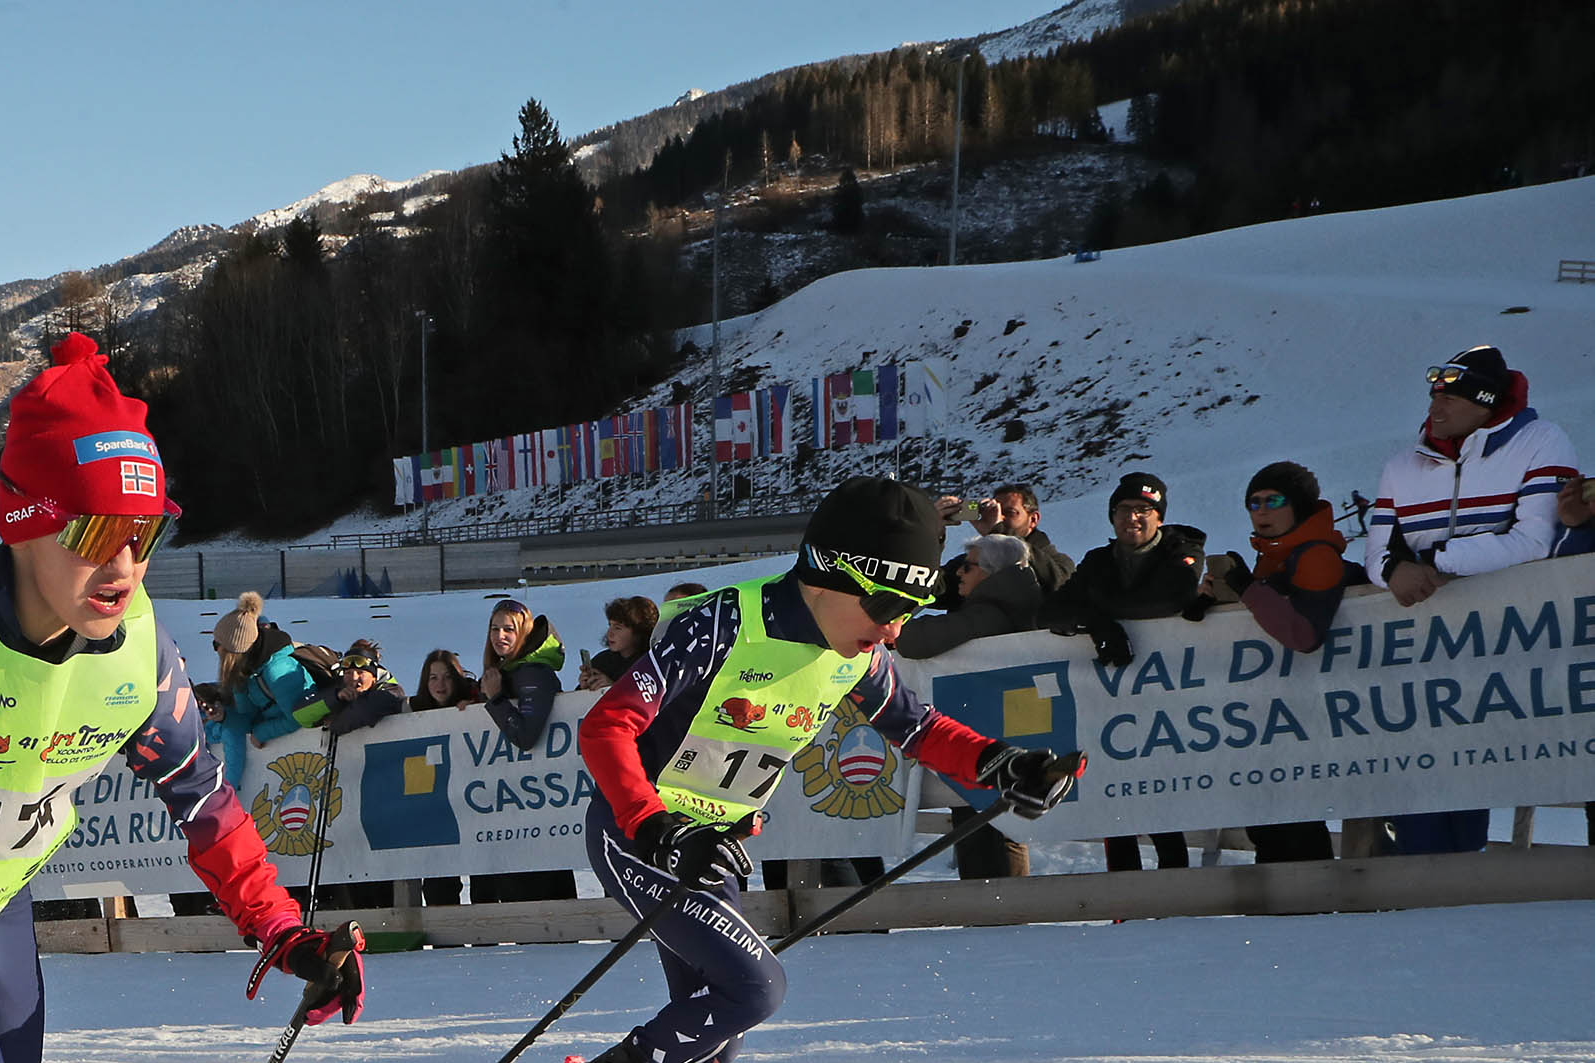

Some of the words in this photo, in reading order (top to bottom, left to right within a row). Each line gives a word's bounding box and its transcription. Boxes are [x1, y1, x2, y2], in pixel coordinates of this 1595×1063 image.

[1476, 390, 1495, 404] HH
[95, 438, 148, 453] SpareBank
[5, 505, 36, 524] CRAF
[1320, 595, 1595, 674] FIEMME
[1100, 697, 1310, 761] CASSA
[1324, 661, 1595, 738] RURALE
[464, 769, 596, 814] CASSA
[1104, 774, 1214, 798] CREDITO
[1229, 753, 1436, 787] COOPERATIVO
[476, 827, 541, 842] CREDITO
[40, 861, 85, 875] CREDITO
[90, 856, 173, 872] COOPERATIVO
[622, 867, 645, 892] S.C.
[682, 898, 763, 961] VALTELLINA
